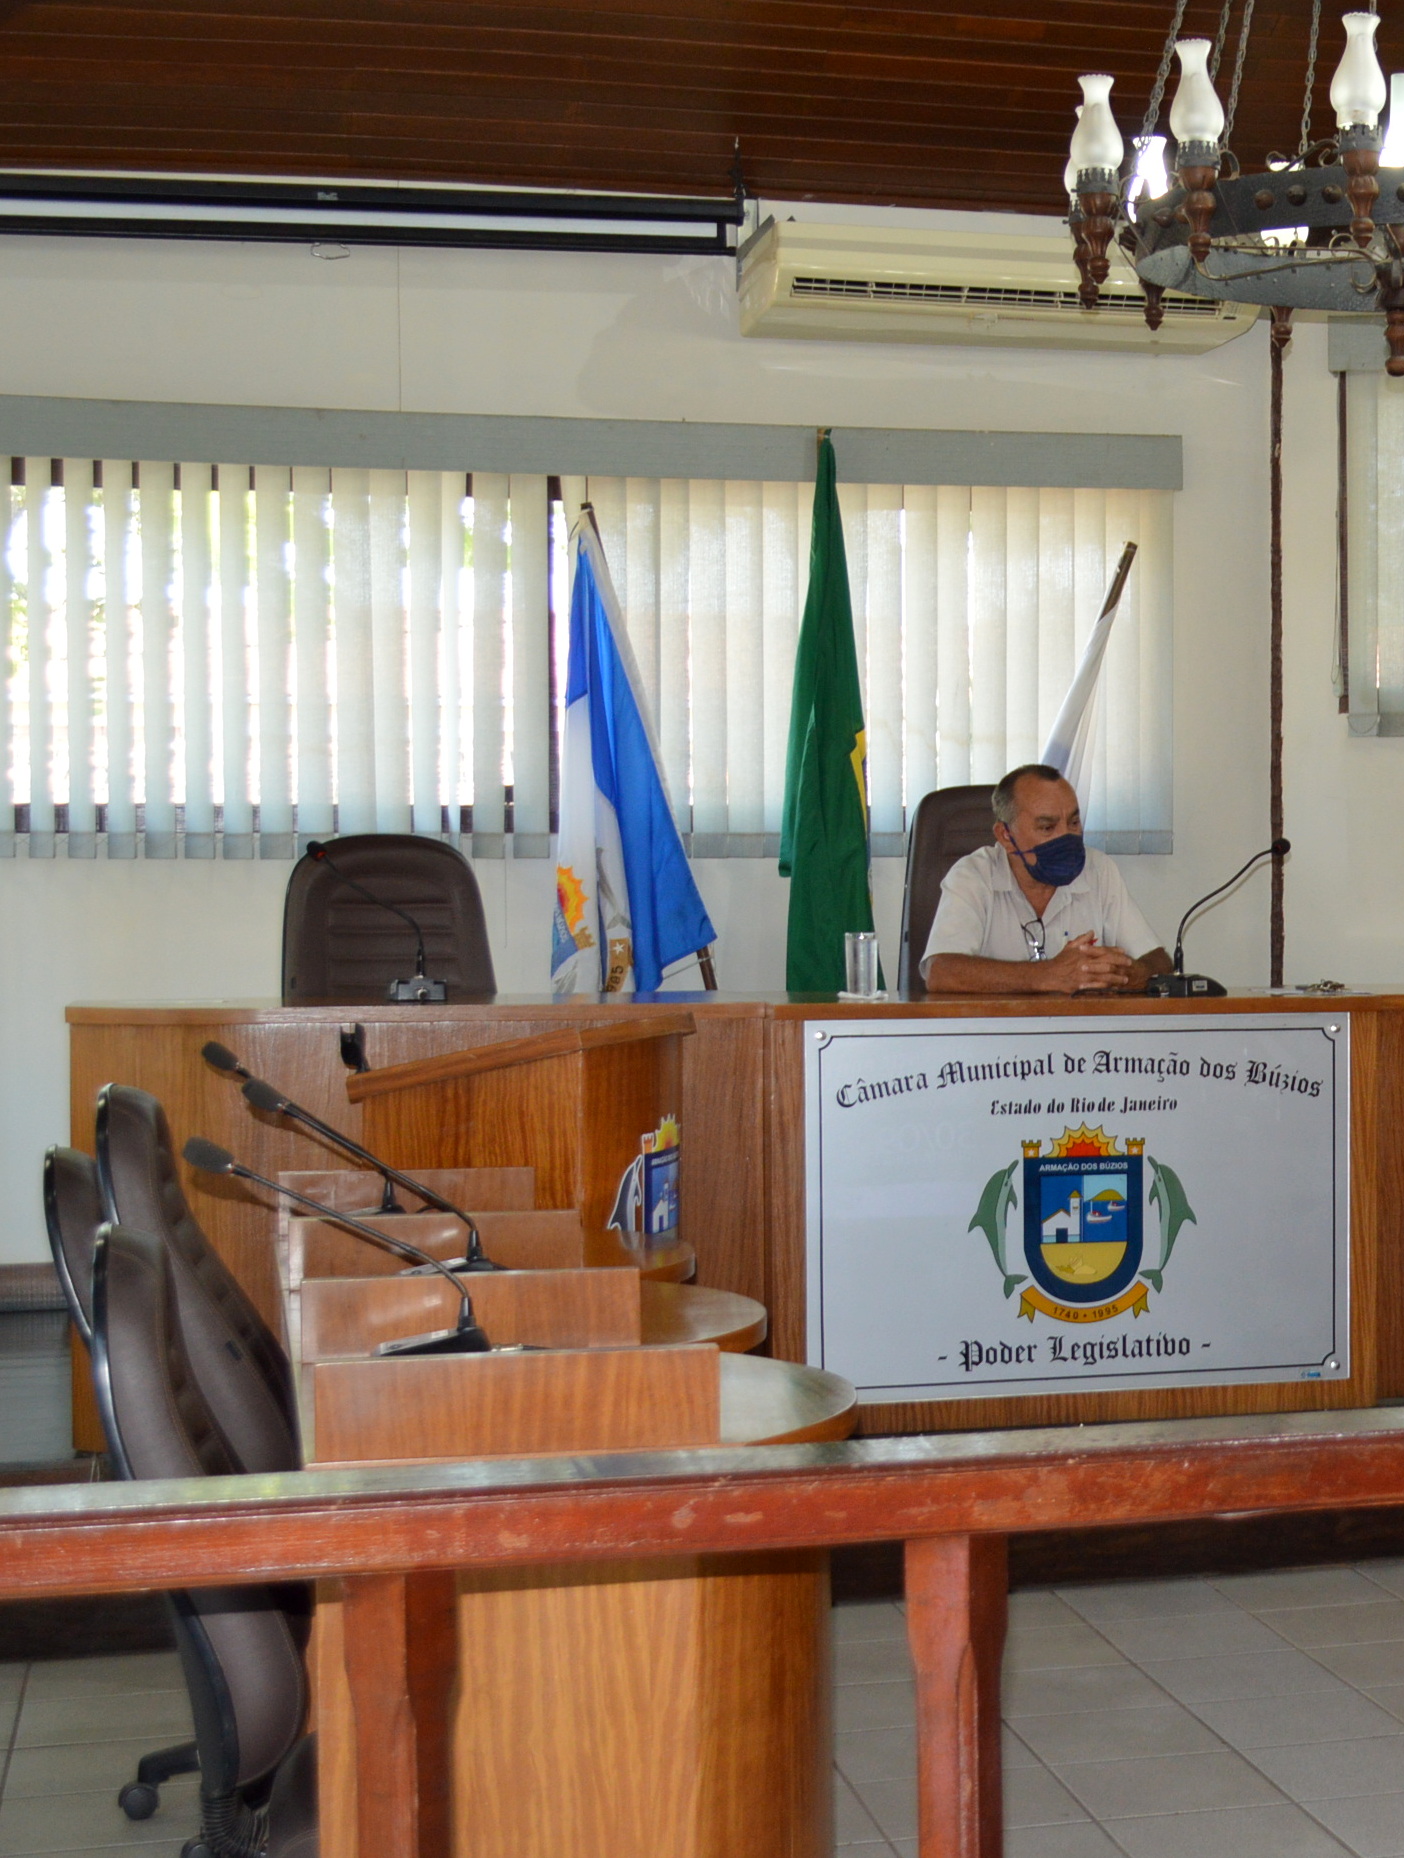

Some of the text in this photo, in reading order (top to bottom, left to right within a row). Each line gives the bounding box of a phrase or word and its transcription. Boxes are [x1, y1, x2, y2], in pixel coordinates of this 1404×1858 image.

[835, 1050, 1324, 1109] Câmara Municipal de Armação dos Búzios
[990, 1095, 1178, 1116] Estado do Rio de Janeiro
[1039, 1160, 1129, 1173] ARMAÇÃO DOS BÚZIOS
[1053, 1303, 1119, 1320] 1740 1995
[957, 1339, 1039, 1372] Poder
[1046, 1332, 1192, 1366] Legislativo
